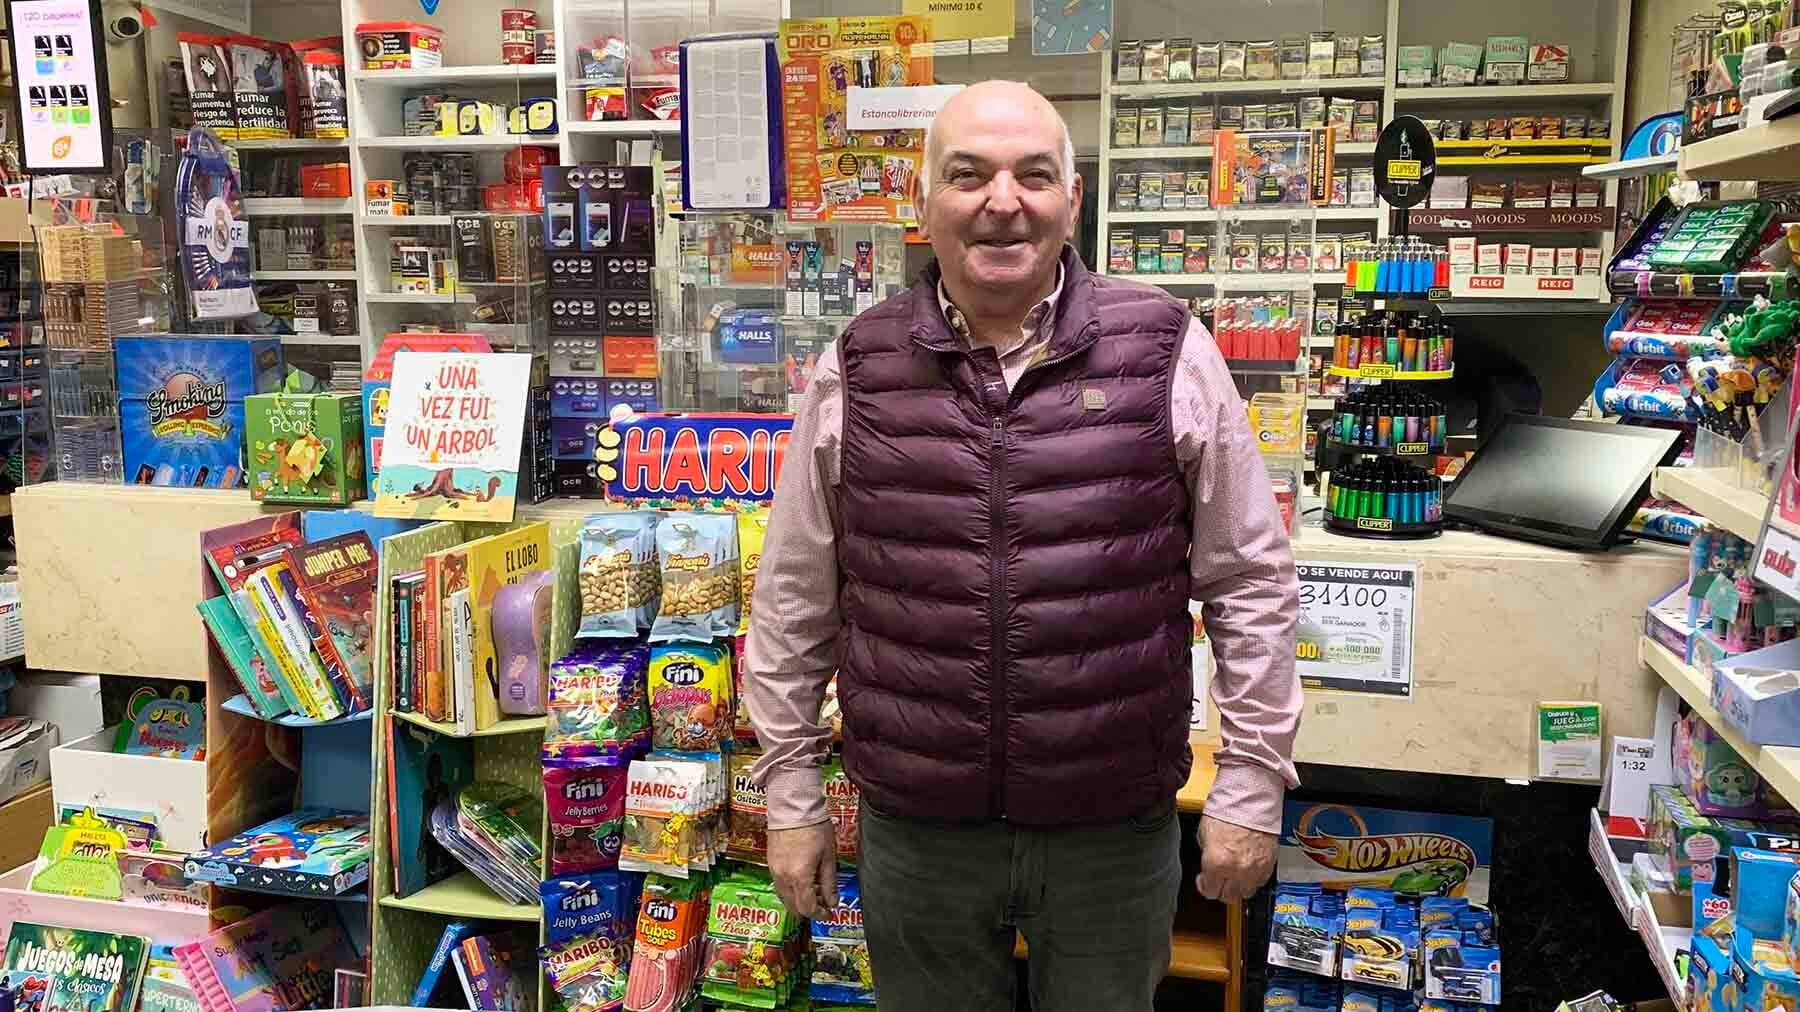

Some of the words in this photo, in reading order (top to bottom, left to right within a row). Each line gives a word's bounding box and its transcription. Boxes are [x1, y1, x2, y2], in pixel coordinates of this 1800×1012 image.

[965, 2, 975, 11] 10
[976, 2, 983, 11] €
[190, 91, 215, 100] Fumar
[235, 92, 270, 103] Fumar
[656, 94, 680, 105] Fuma
[194, 109, 218, 119] riesgo
[237, 105, 273, 116] reduce
[275, 105, 286, 117] la
[238, 118, 288, 129] fertilidad
[567, 168, 625, 189] OCB
[369, 208, 389, 216] mata
[1475, 213, 1526, 225] MOODS
[1550, 212, 1602, 224] MOODS
[198, 224, 213, 238] RM
[229, 225, 243, 239] CF
[748, 251, 783, 262] HALLS
[552, 259, 593, 273] OCB
[608, 258, 649, 273] OCB
[1471, 278, 1501, 287] REIG
[1541, 279, 1571, 288] REIG
[552, 300, 596, 315] OCB
[608, 300, 651, 316] OCB
[738, 331, 773, 341] HALLS
[439, 366, 477, 390] UNA
[555, 381, 598, 396] OCB
[609, 381, 655, 396] OCB
[147, 381, 226, 426] Smoking
[421, 397, 456, 420] VEZ
[459, 397, 492, 421] FUI
[406, 425, 432, 451] UN
[436, 423, 497, 455] ÁRBOL
[1399, 445, 1426, 453] CLIPPER
[1359, 520, 1390, 529] CLIPPER
[304, 548, 349, 577] JUNIPER
[505, 551, 517, 574] EL
[518, 543, 539, 570] LOBO
[1310, 567, 1326, 577] SE
[1328, 568, 1369, 579] VENDE
[1299, 583, 1387, 608] 31100
[665, 666, 700, 684] Fini
[1621, 760, 1647, 772] 1:32
[565, 780, 604, 801] Fini
[630, 780, 687, 800] HARIBO
[736, 794, 764, 806] Ositos
[565, 805, 583, 818] Jelly
[562, 889, 599, 912] Fini
[1704, 900, 1730, 910] +60
[646, 901, 675, 921] Fini
[716, 903, 780, 927] HARIBO
[553, 917, 578, 930] Jelly
[580, 910, 612, 926] Beans
[640, 918, 677, 941] Tubes
[17, 940, 76, 977] JUEGOS
[81, 952, 124, 984] MESA
